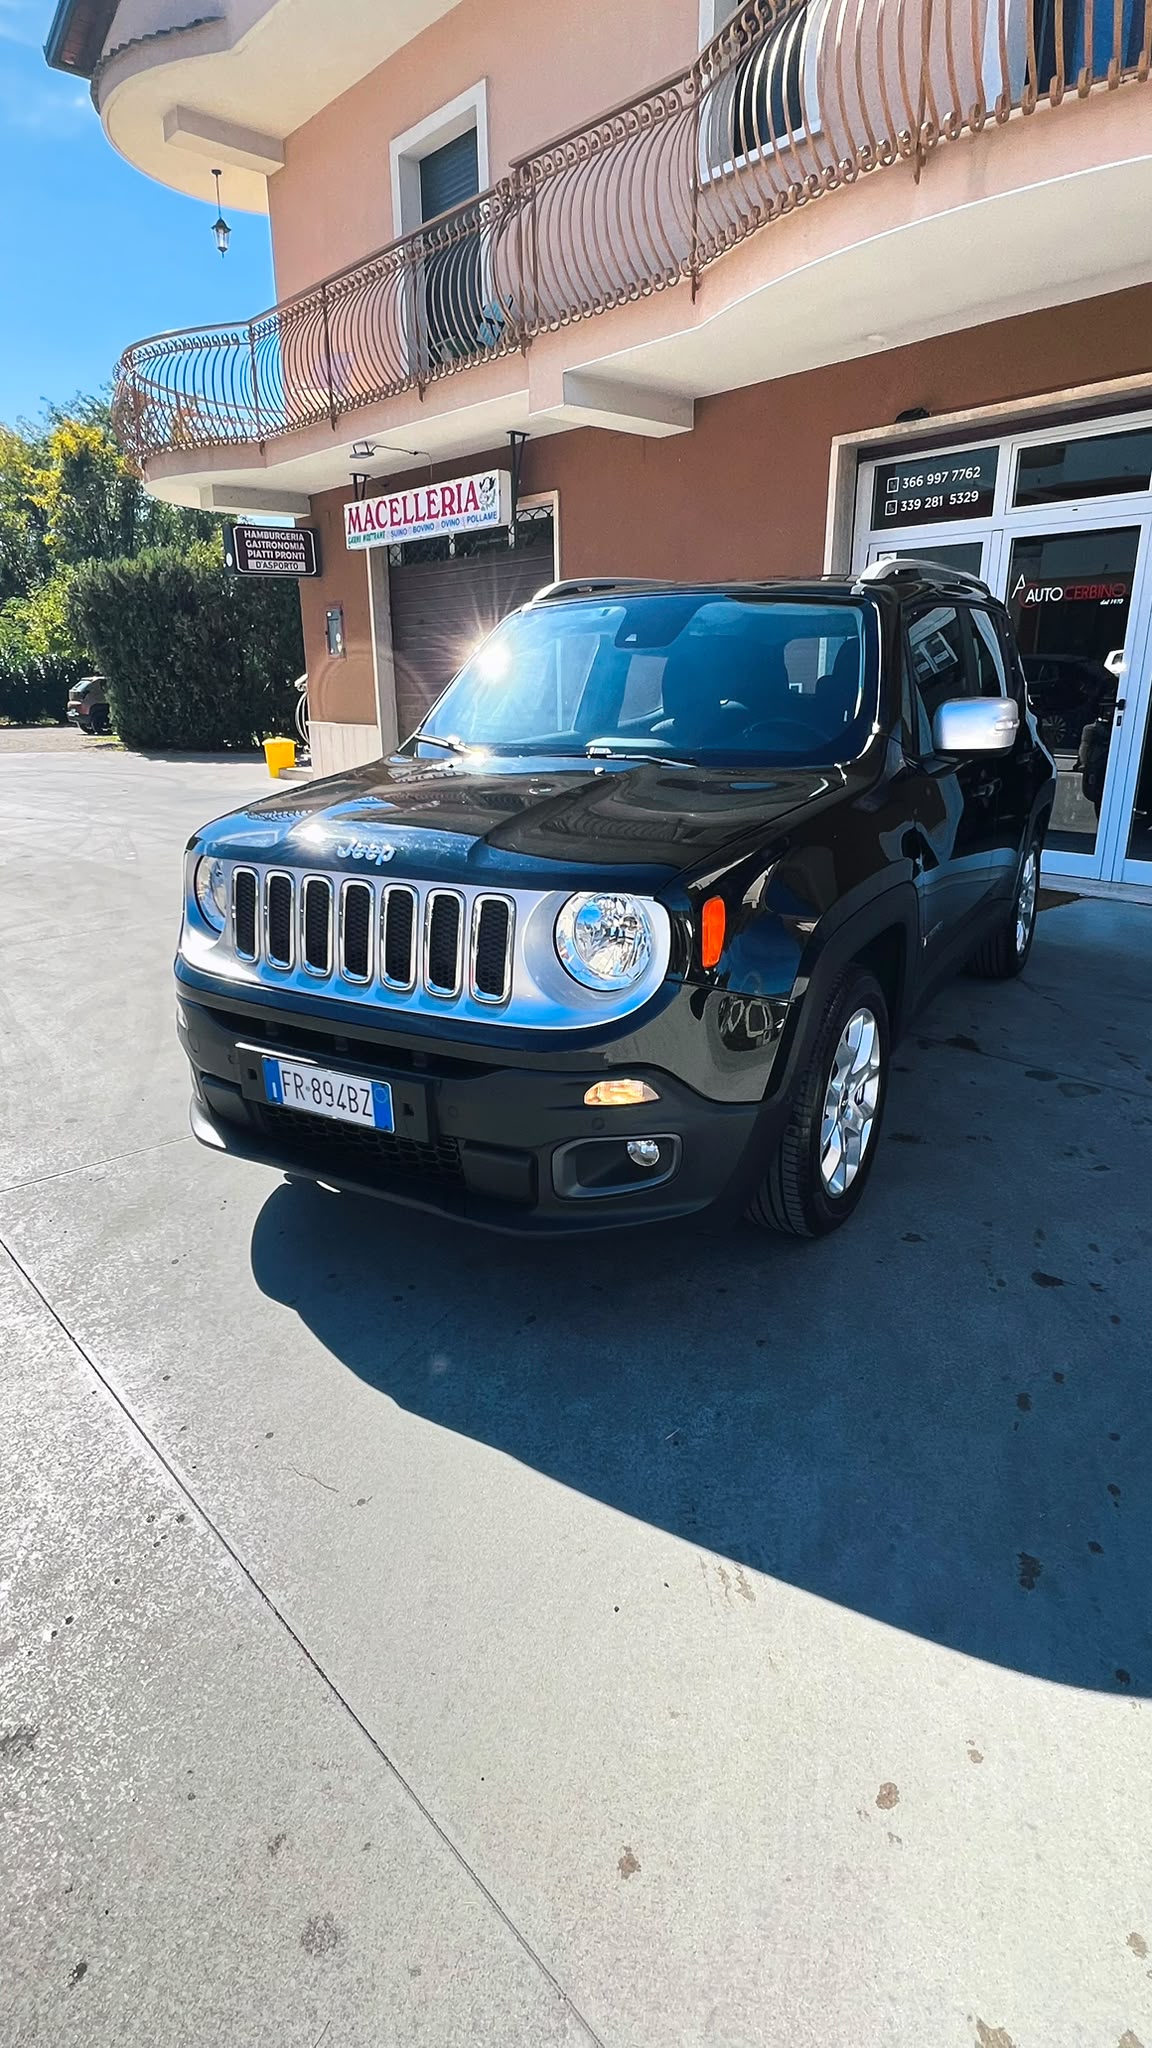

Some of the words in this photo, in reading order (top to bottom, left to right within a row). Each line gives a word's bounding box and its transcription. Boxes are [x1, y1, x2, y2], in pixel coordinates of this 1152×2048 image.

[902, 476, 924, 489] 366
[926, 471, 949, 485] 997
[951, 466, 981, 482] 7762
[347, 480, 480, 535] MACELLERIA
[900, 498, 922, 512] 339
[924, 495, 944, 509] 281
[949, 490, 979, 505] 5329
[390, 527, 408, 538] SUINO
[412, 522, 435, 534] BOVINO
[440, 517, 461, 529] OVINO
[466, 510, 498, 524] POLLAME
[243, 529, 305, 542] HAMBURGERIA
[245, 539, 305, 551] GASTRONOMIA
[247, 549, 274, 559] PIATTI
[275, 551, 306, 561] PRONTI
[255, 561, 299, 570] D'ASPORTO
[1025, 586, 1063, 603] AUTO
[1064, 582, 1127, 600] CERBINO
[336, 837, 397, 866] Jeep
